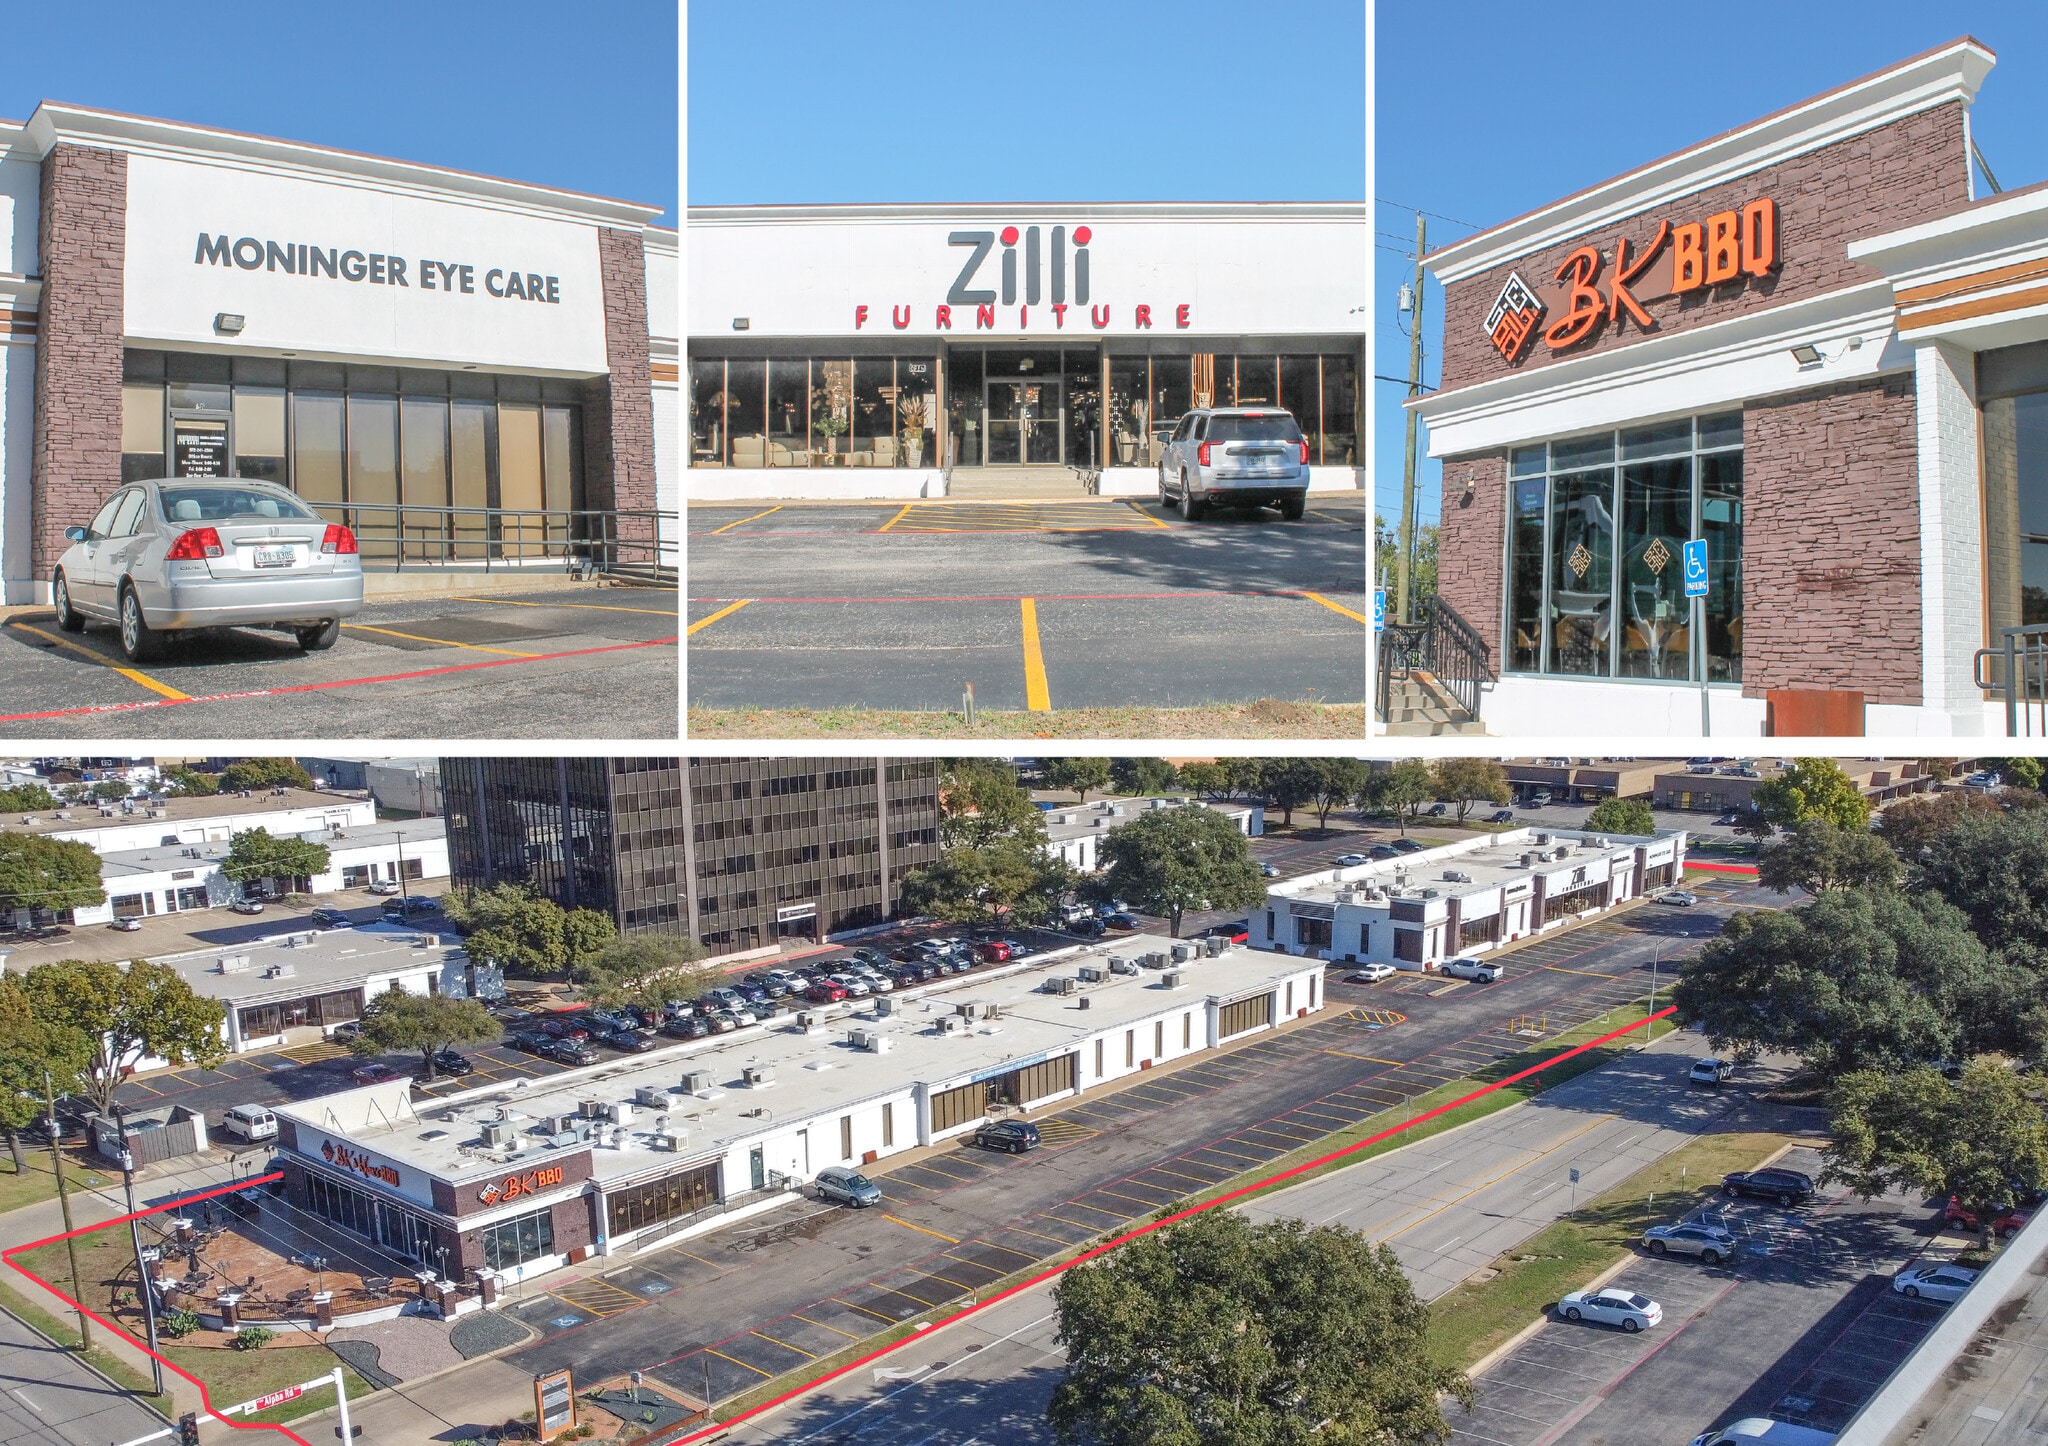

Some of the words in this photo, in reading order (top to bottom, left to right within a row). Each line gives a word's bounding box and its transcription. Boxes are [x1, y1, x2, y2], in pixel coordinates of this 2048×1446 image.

[195, 232, 409, 287] MONINGER
[420, 259, 475, 295] EYE
[484, 267, 560, 304] CARE
[947, 226, 1092, 306] Zilli
[1544, 219, 1669, 349] BK
[1670, 197, 1774, 294] BBQ
[856, 303, 1191, 330] FURNITURE
[1687, 580, 1707, 591] PARKING
[502, 1170, 537, 1201] BK
[537, 1166, 563, 1187] BBQ
[264, 1392, 284, 1405] Alpha
[284, 1388, 294, 1399] Rd
